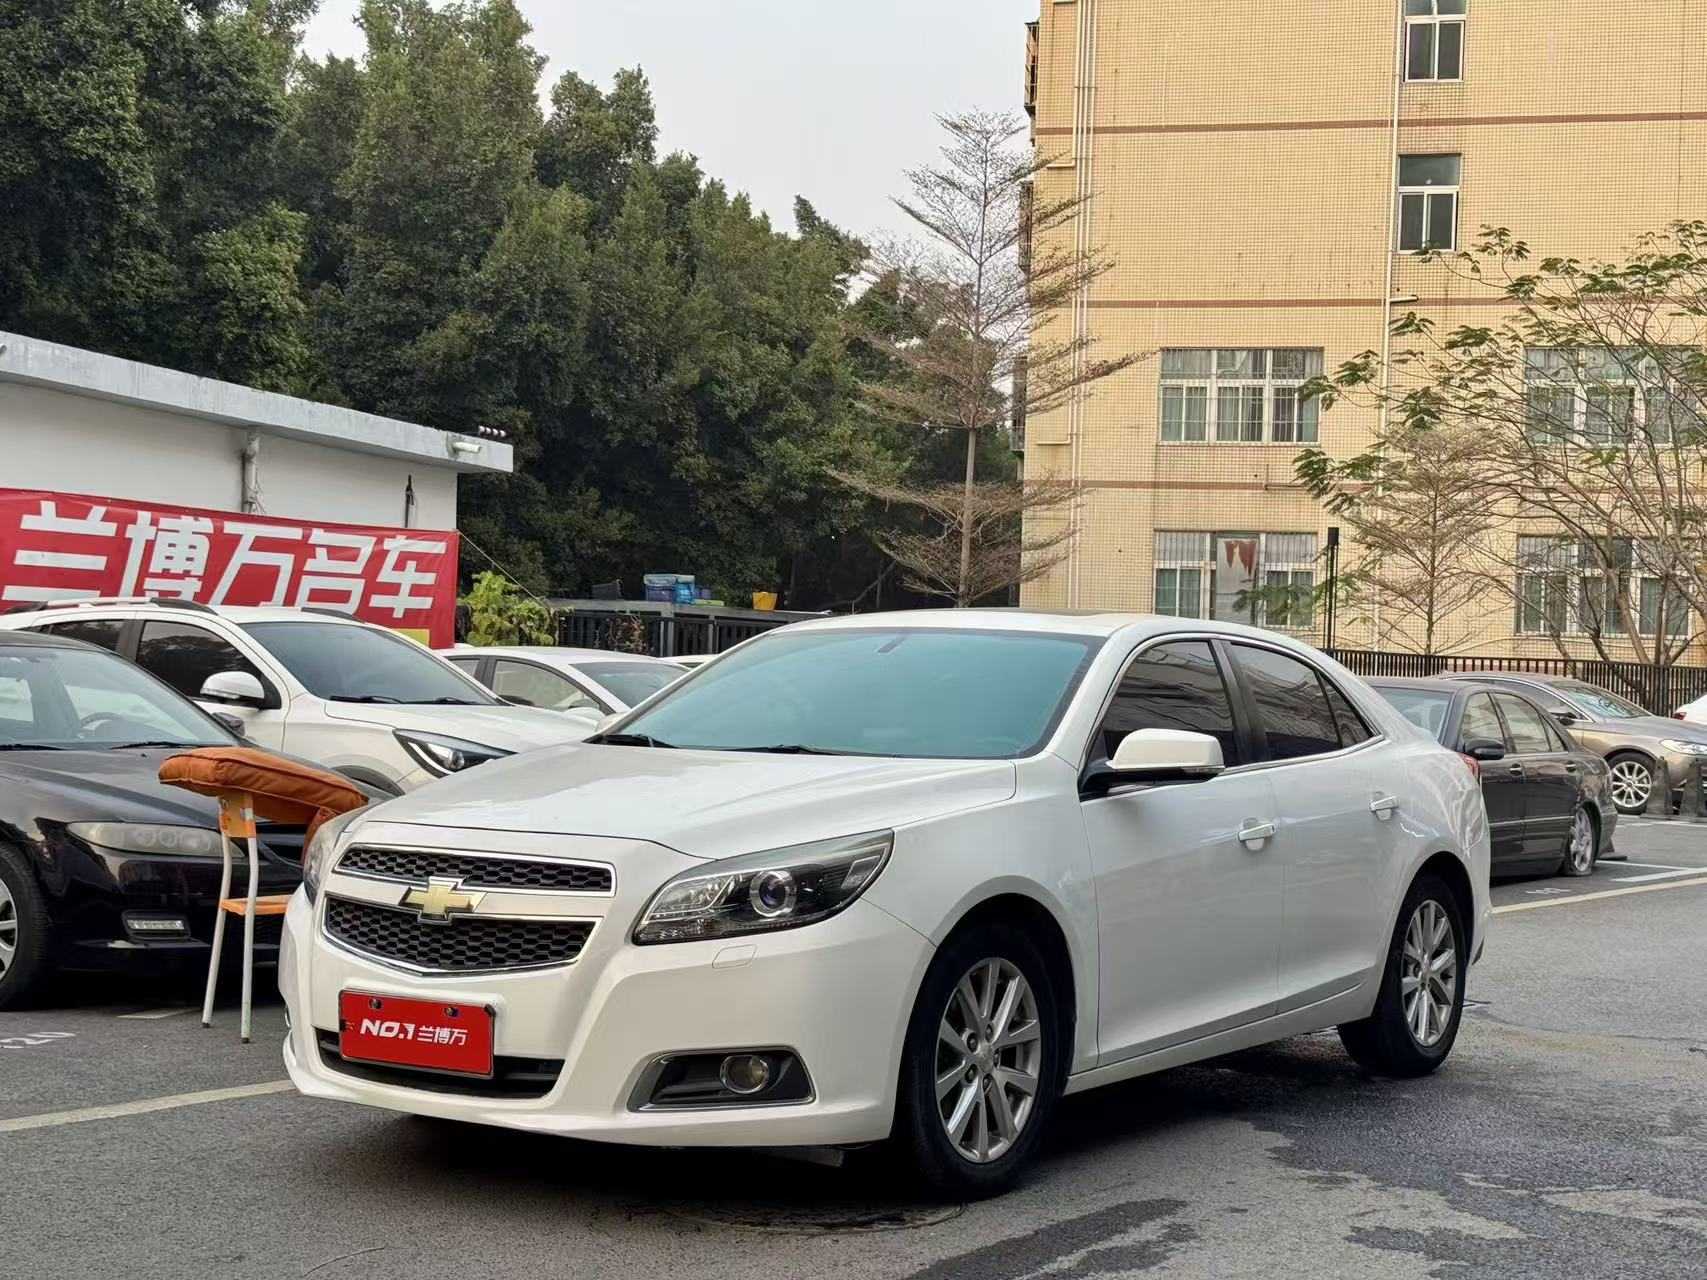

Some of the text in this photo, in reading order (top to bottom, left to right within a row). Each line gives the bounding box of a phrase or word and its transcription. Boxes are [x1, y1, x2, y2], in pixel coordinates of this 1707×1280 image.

[1, 500, 447, 618] 兰博万名车
[360, 1018, 468, 1046] NO.1 兰博万
